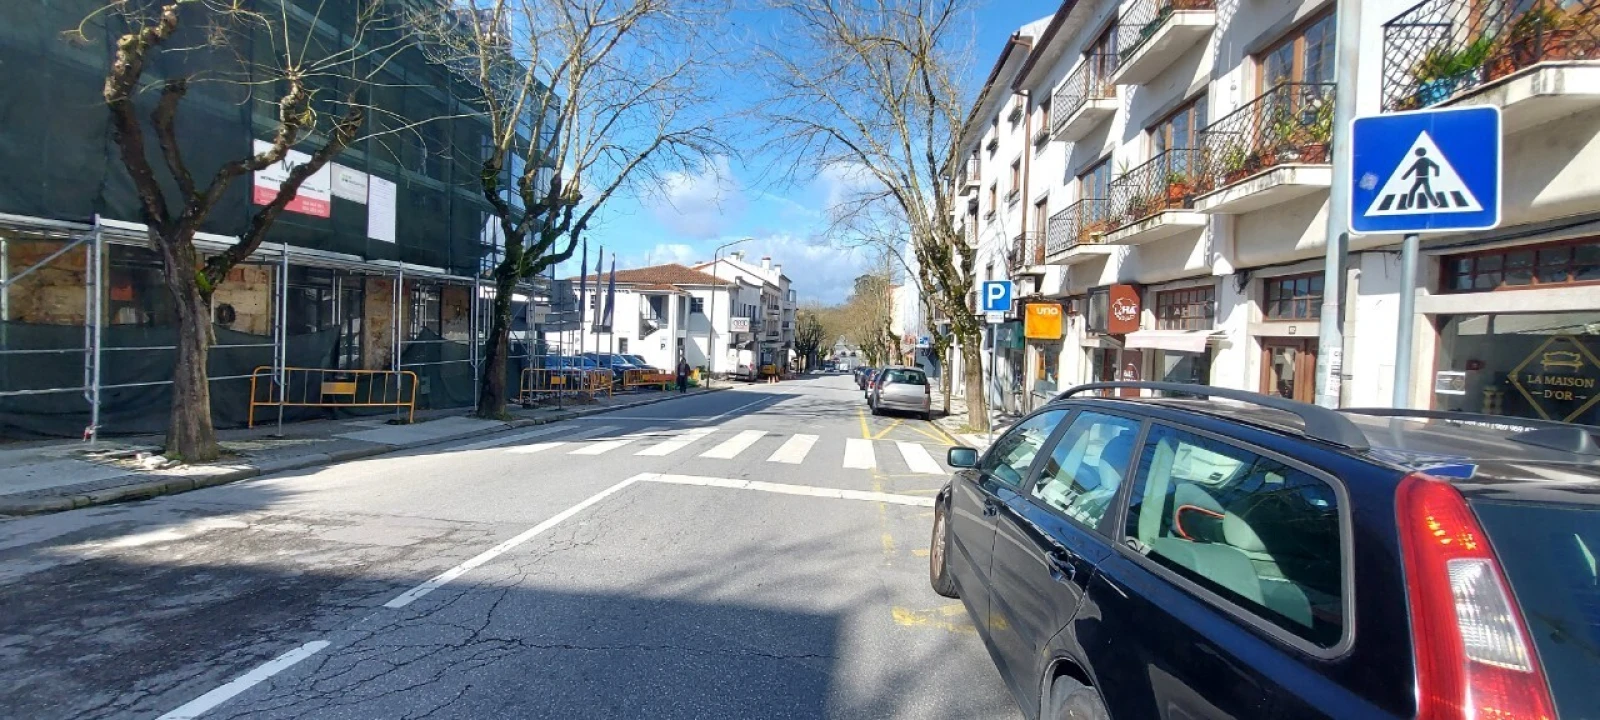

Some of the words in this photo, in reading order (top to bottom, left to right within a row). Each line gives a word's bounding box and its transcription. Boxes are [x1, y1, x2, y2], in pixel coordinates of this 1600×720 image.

[988, 283, 1006, 309] P
[1036, 307, 1059, 315] uno
[1526, 374, 1543, 385] LA
[1544, 375, 1596, 389] MAISON
[1544, 389, 1574, 401] D'OR
